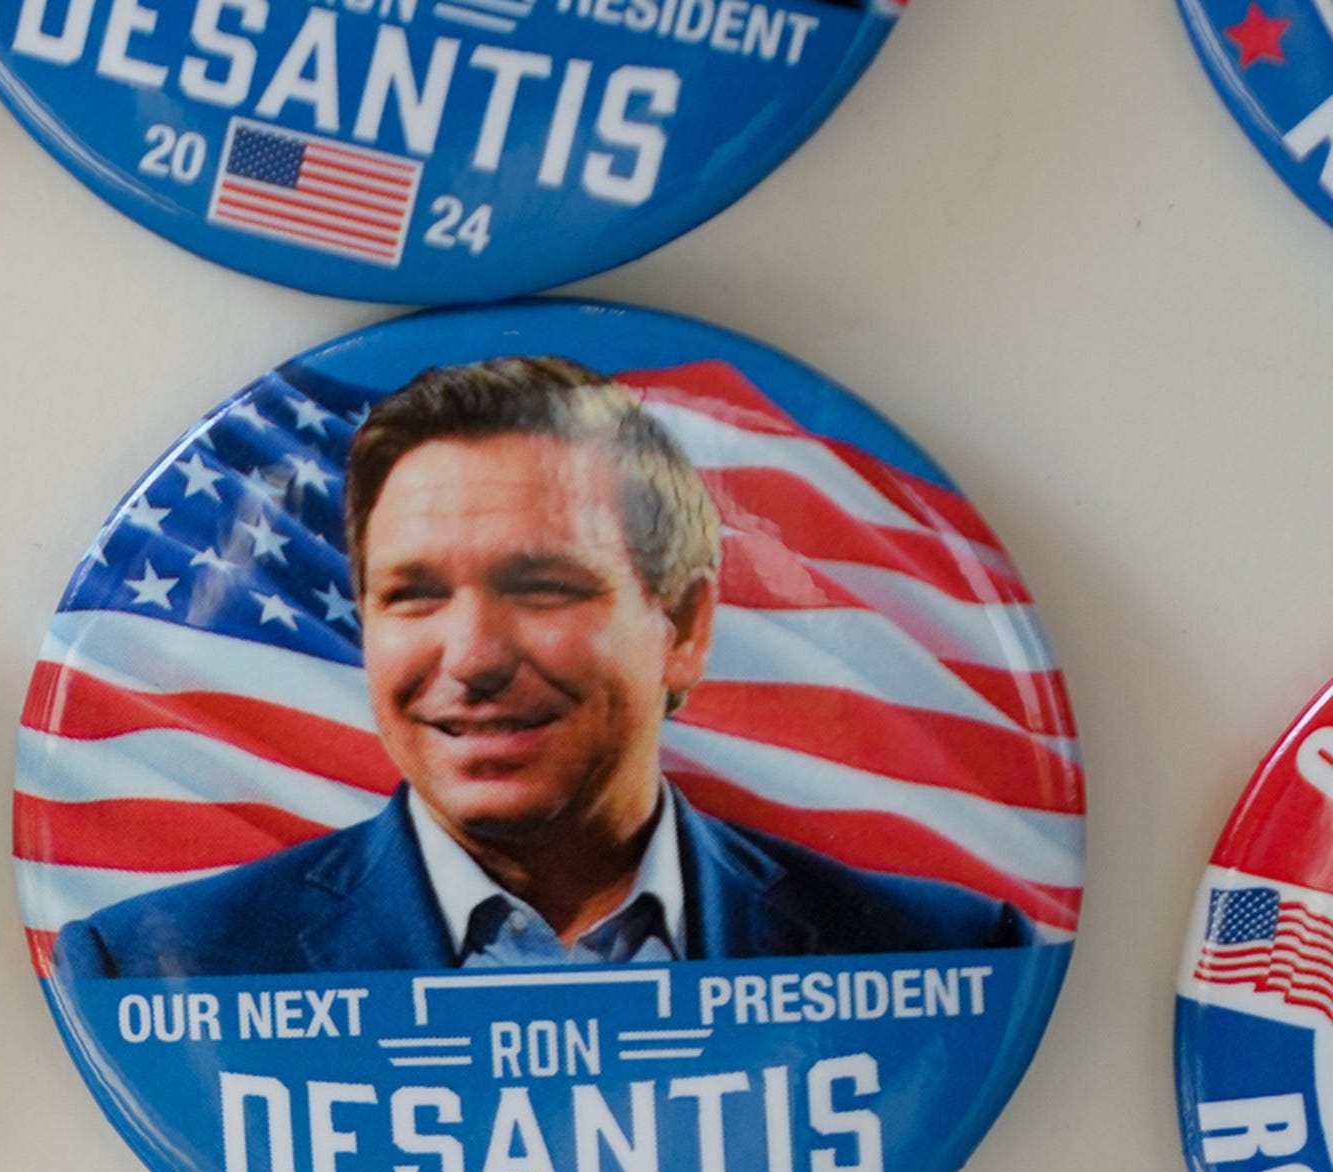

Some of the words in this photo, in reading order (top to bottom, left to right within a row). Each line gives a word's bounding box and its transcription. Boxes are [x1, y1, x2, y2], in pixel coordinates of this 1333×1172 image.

[11, 0, 683, 207] DESANTIS
[138, 124, 207, 184] 20
[424, 195, 493, 255] 24
[119, 993, 221, 1042] OUR
[238, 989, 370, 1038] NEXT
[700, 967, 993, 1025] PRESIDENT
[491, 1019, 601, 1078] RON
